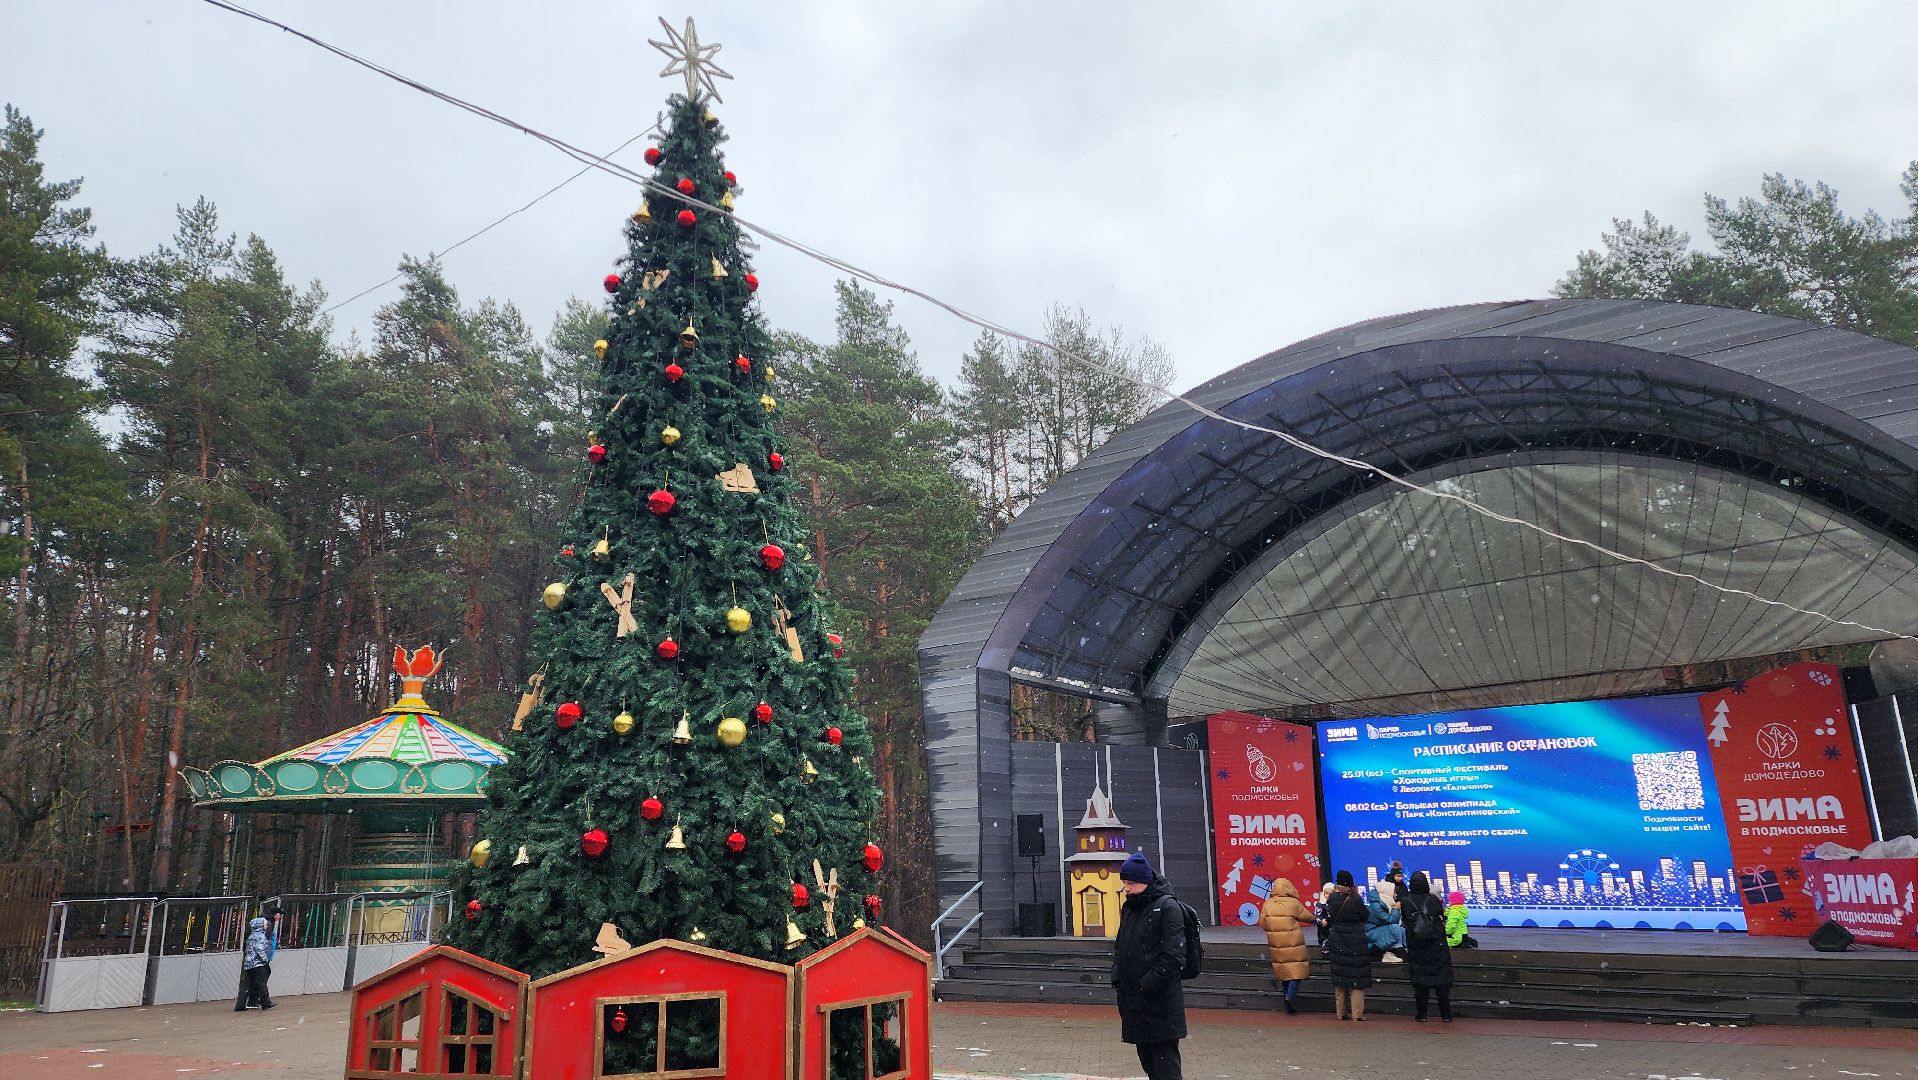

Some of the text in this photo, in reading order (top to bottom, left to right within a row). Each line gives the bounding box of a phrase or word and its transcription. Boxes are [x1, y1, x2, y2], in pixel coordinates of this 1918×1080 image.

[1327, 727, 1357, 738] ЗИМА
[1413, 736, 1598, 757] РАСПИСАНИЕ ОСТАНОВОК
[1761, 762, 1801, 771] ПАРКИ
[1342, 770, 1365, 779] 25.01
[1743, 769, 1825, 782] ДОМОДЕДОВО
[1250, 786, 1279, 794] ПАРКИ
[1232, 793, 1299, 801] ПОДМОСКОВЬЯ
[1736, 795, 1845, 822] ЗИМА
[1228, 813, 1306, 834] ЗИМА
[1741, 824, 1848, 837] В ПОДМОСКОВЬЕ
[1230, 837, 1307, 847] В ПОДМОСКОВЬЕ
[1823, 872, 1899, 905] ЗИМА
[1830, 911, 1904, 926] В ПОДМОСКОВЬЕ
